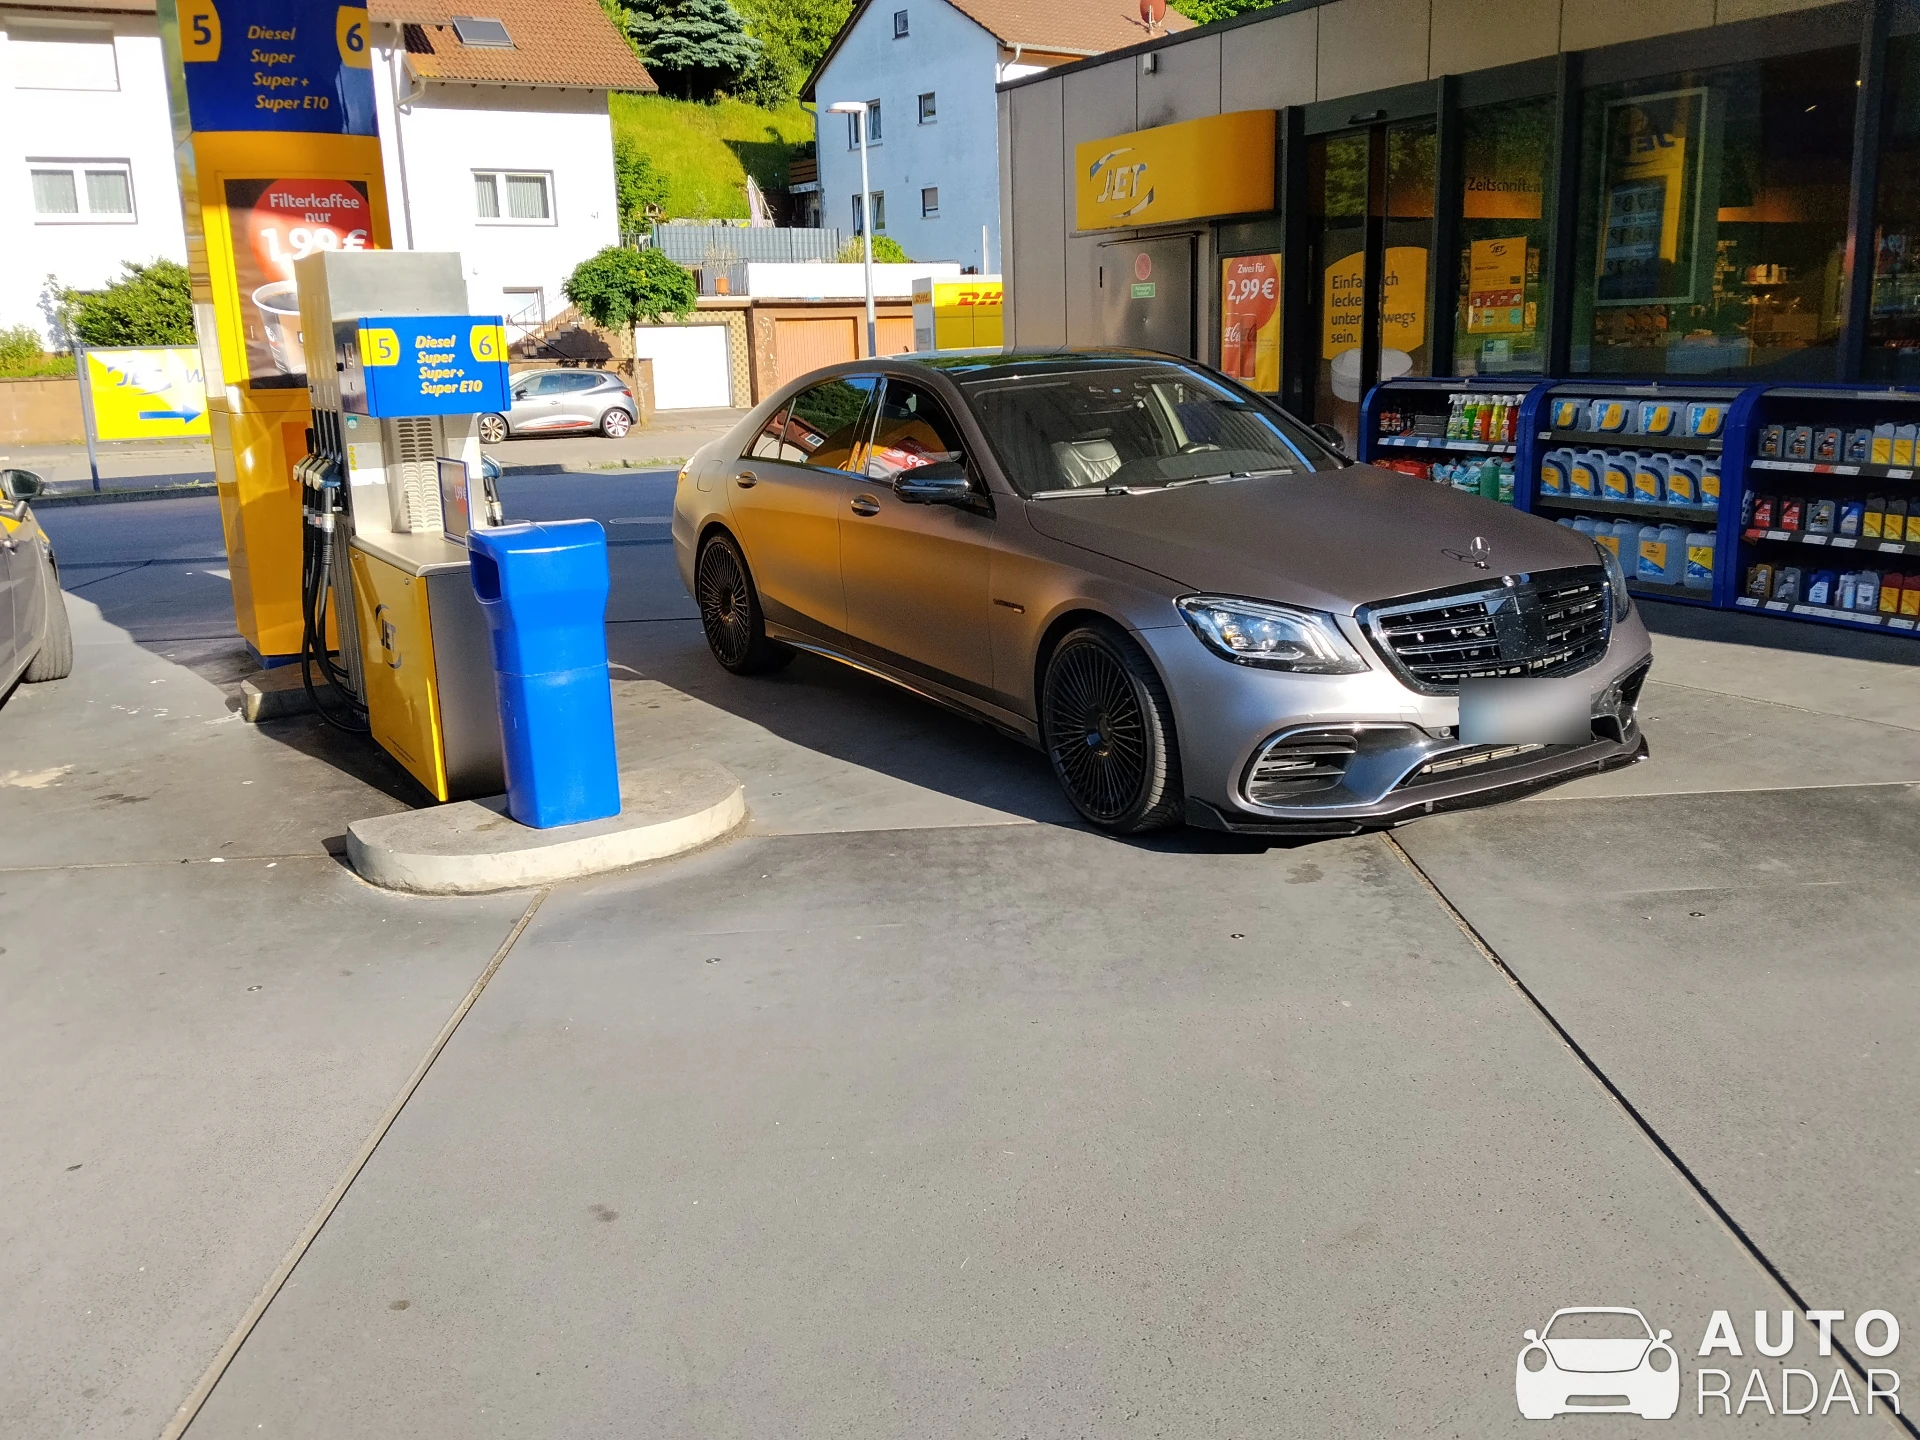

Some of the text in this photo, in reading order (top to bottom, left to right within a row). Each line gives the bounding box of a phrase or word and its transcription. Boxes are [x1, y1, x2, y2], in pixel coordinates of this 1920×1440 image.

[193, 14, 212, 45] 5
[247, 25, 297, 41] Diesel
[346, 23, 364, 52] 6
[250, 49, 296, 65] Super
[253, 72, 298, 90] Super
[255, 94, 329, 113] Super E10
[1097, 164, 1148, 203] JET
[269, 193, 360, 209] Filterkaffee
[305, 211, 331, 223] nur
[1237, 263, 1255, 274] Zwei
[957, 291, 1004, 306] DH
[415, 334, 457, 348] Diesel
[1331, 329, 1357, 343] sein.
[378, 338, 392, 359] 5
[478, 335, 492, 356] 6
[416, 351, 455, 366] Super
[420, 380, 483, 397] Super E10
[381, 618, 397, 654] JET
